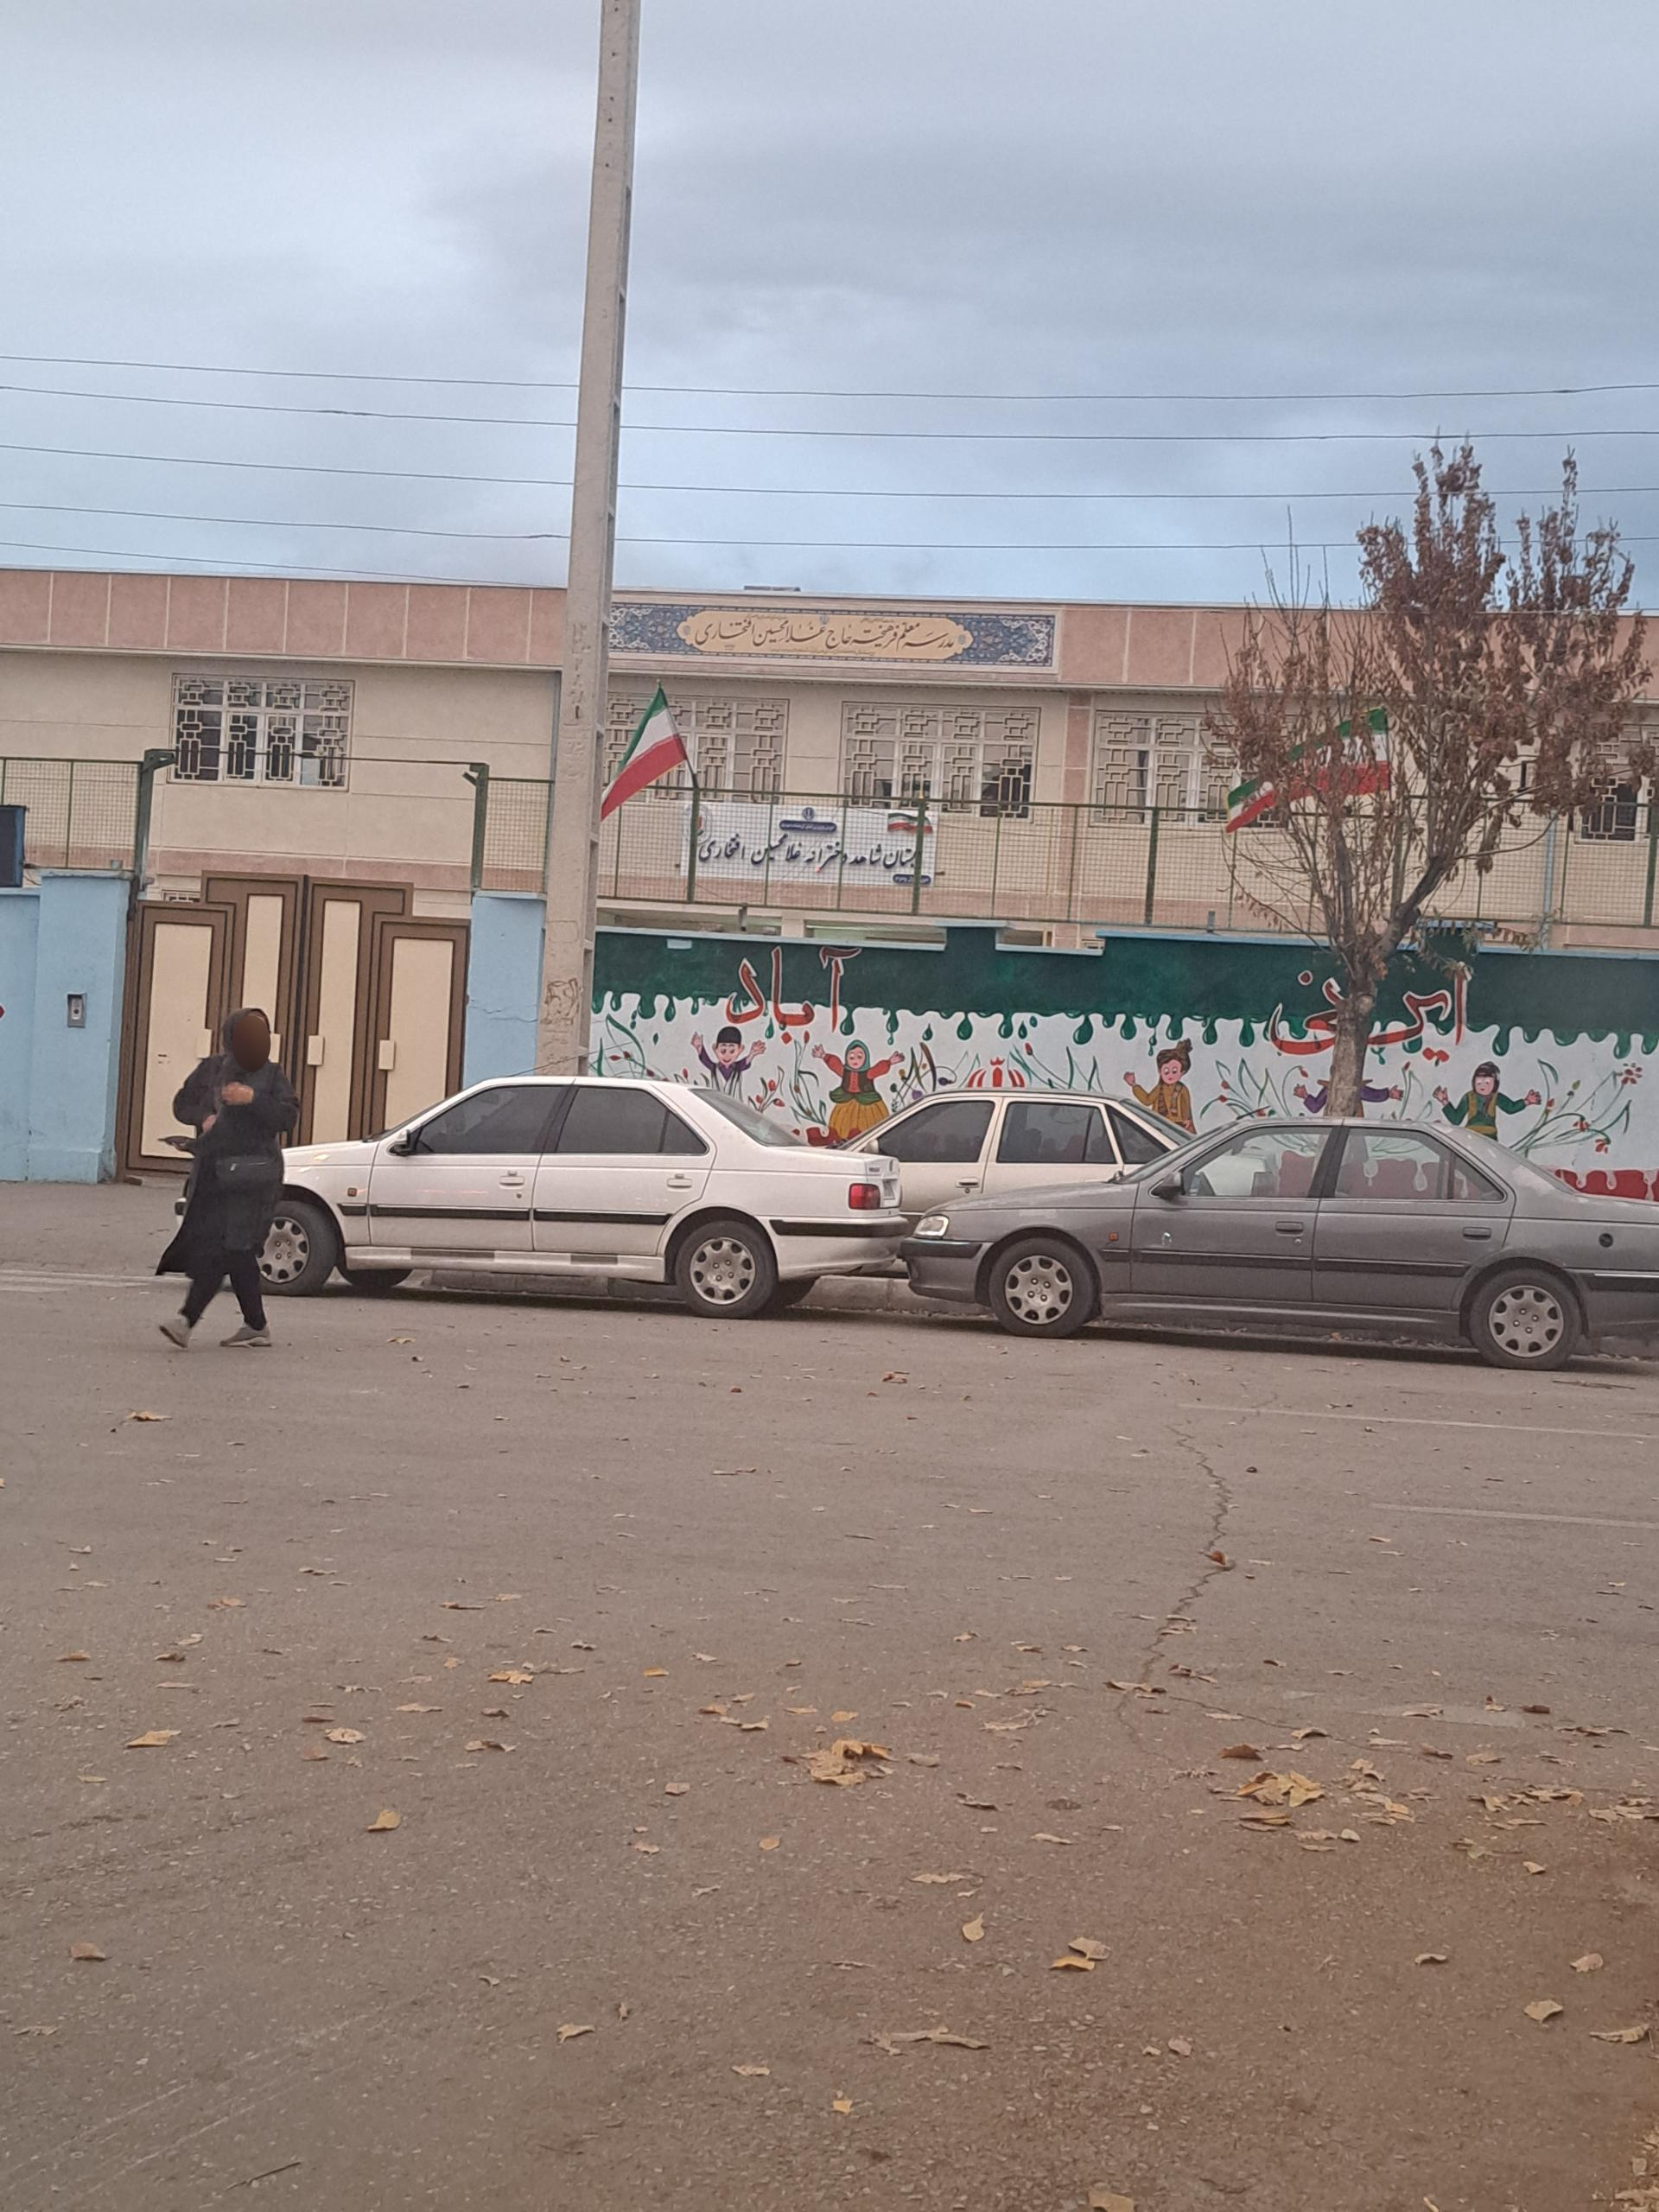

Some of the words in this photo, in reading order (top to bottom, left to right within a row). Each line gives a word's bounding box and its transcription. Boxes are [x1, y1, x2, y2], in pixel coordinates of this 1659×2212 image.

[695, 618, 754, 646] افتخاری
[753, 620, 825, 647] غلامحسین
[825, 624, 852, 649] حاج
[903, 632, 955, 649] مدرسه
[698, 834, 746, 862] افتخاری
[804, 842, 849, 869] دخترانه
[849, 843, 882, 865] شاهد
[883, 848, 918, 868] بستان
[725, 945, 862, 1045] آباد
